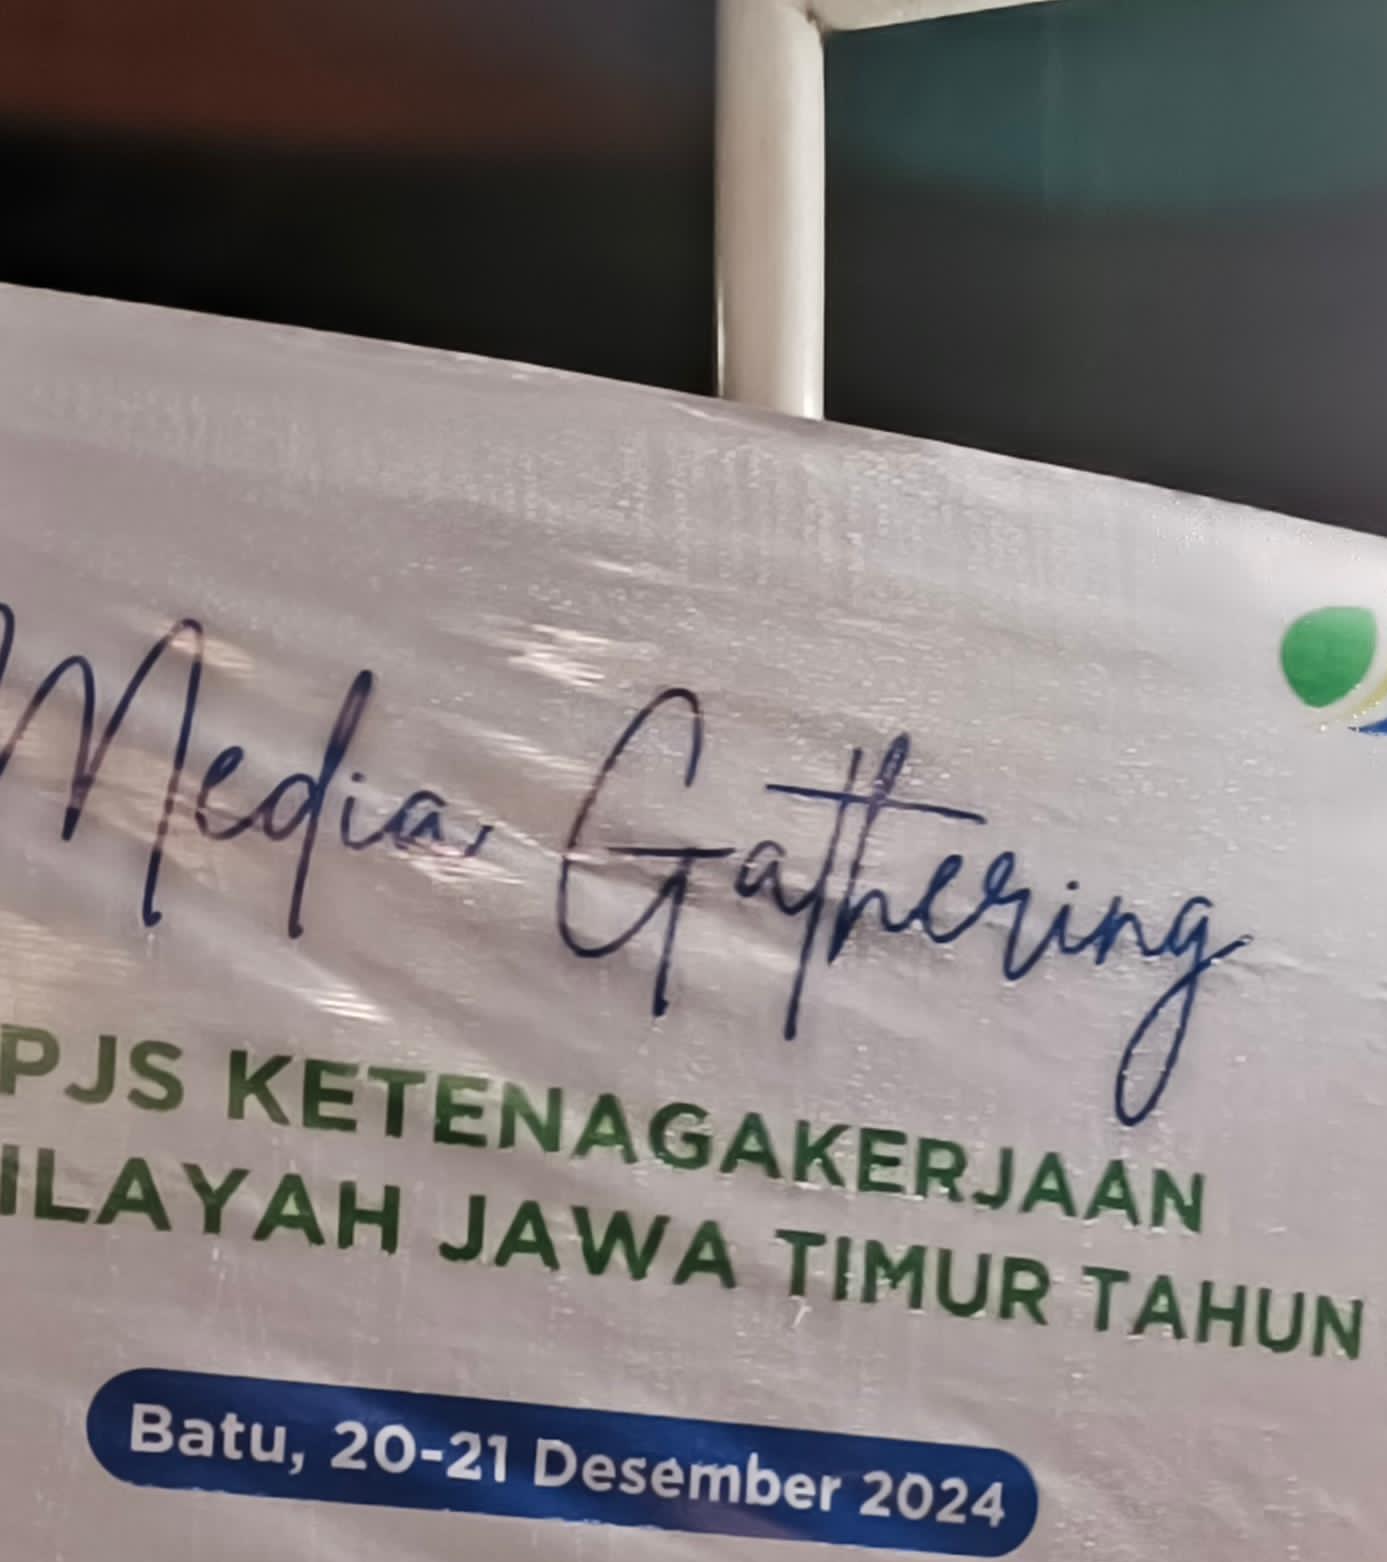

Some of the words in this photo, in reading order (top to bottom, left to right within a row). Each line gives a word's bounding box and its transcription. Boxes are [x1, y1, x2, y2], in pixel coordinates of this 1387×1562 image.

[0, 603, 493, 938] Media
[556, 686, 1255, 1127] Gathering
[0, 1022, 185, 1113] PJS
[226, 1049, 1207, 1235] KETENAGAKERJAAN
[0, 1143, 401, 1256] ILAYAH
[438, 1194, 738, 1290] JAWA
[774, 1228, 1053, 1327] TIMUR
[1080, 1264, 1364, 1361] TAHUN
[129, 1401, 304, 1476] Batu,
[329, 1419, 509, 1484] 20-21
[532, 1437, 842, 1514] Desember
[858, 1469, 1006, 1530] 2024
